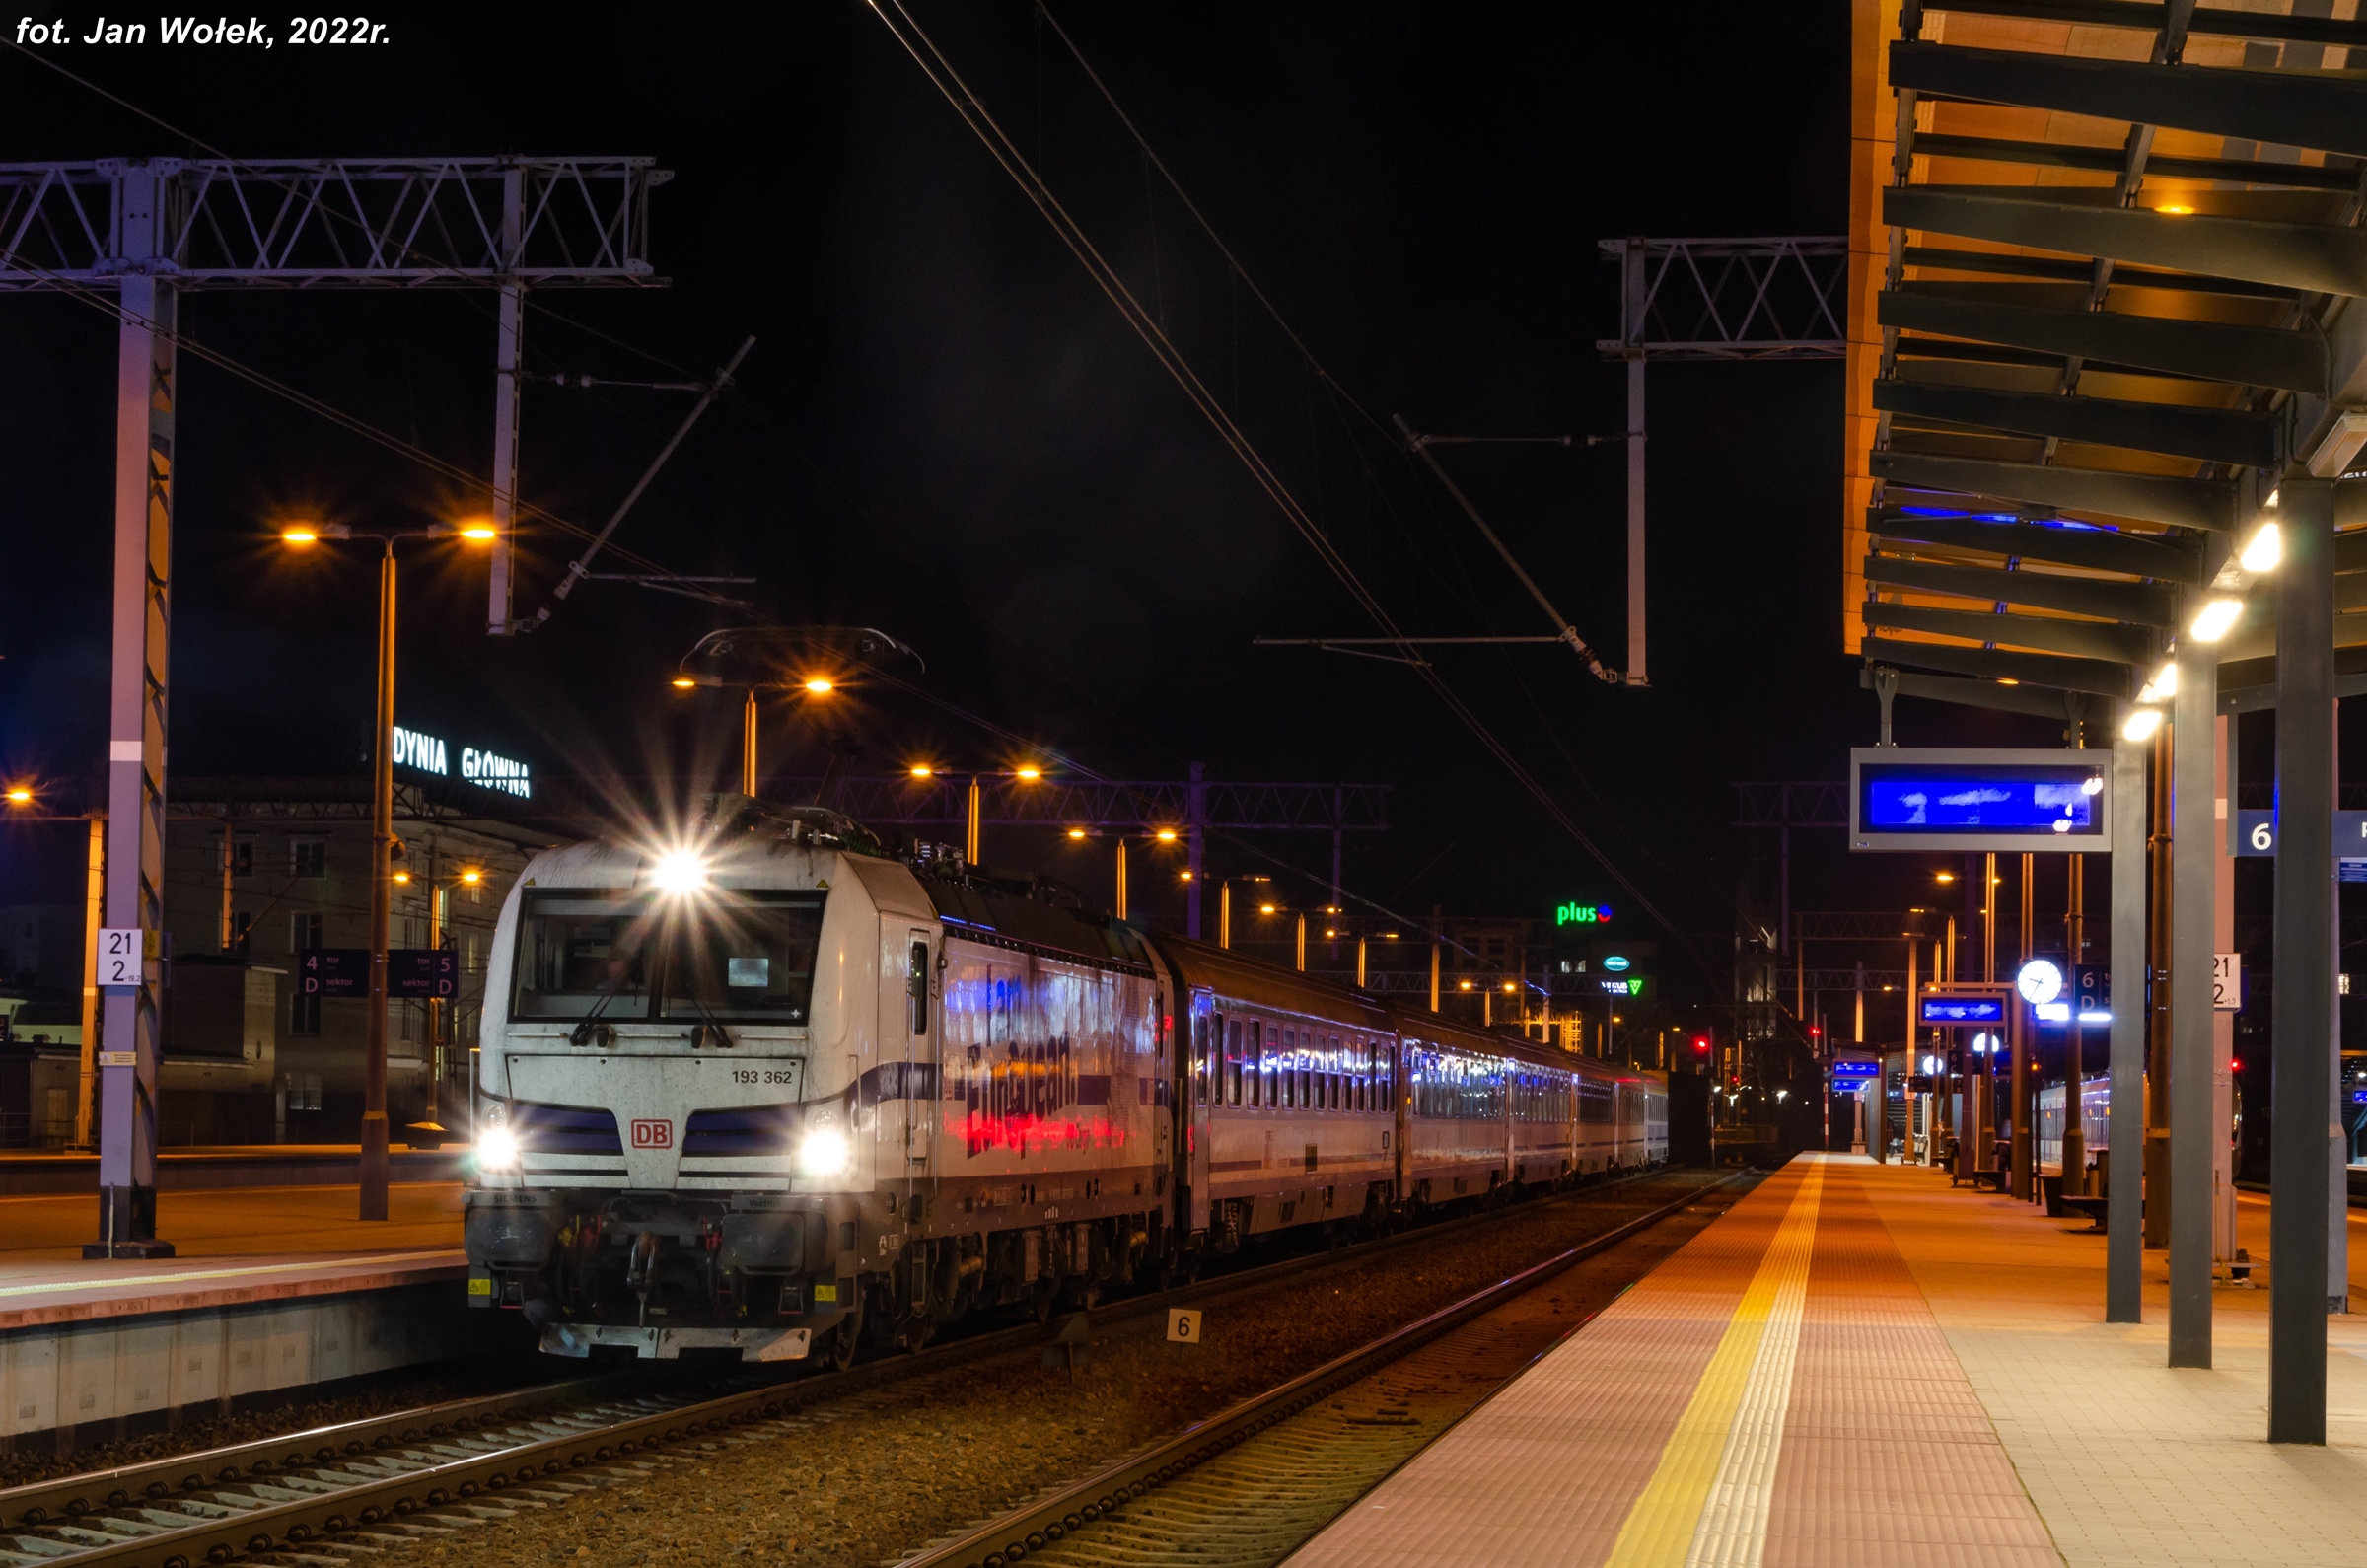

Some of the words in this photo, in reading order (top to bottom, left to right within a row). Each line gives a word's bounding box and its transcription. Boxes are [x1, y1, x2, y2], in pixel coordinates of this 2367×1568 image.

[393, 726, 447, 776] DYNIA
[2251, 822, 2272, 851] 6
[1557, 901, 1597, 926] plus
[109, 932, 131, 955] 21
[112, 960, 125, 982] 2
[306, 955, 318, 971] 4
[326, 956, 340, 964] tor
[417, 957, 431, 965] tor
[440, 957, 451, 973] 5
[305, 977, 319, 993] D
[325, 977, 354, 987] sektor
[402, 978, 431, 987] sektor
[439, 979, 453, 995] D
[2082, 971, 2094, 988] 6
[2081, 995, 2095, 1012] D
[1951, 1053, 1958, 1062] 6
[732, 1070, 759, 1084] 193
[763, 1070, 793, 1085] 362
[634, 1122, 670, 1146] DB
[493, 1194, 538, 1203] SIEMENS
[1178, 1316, 1191, 1338] 6
